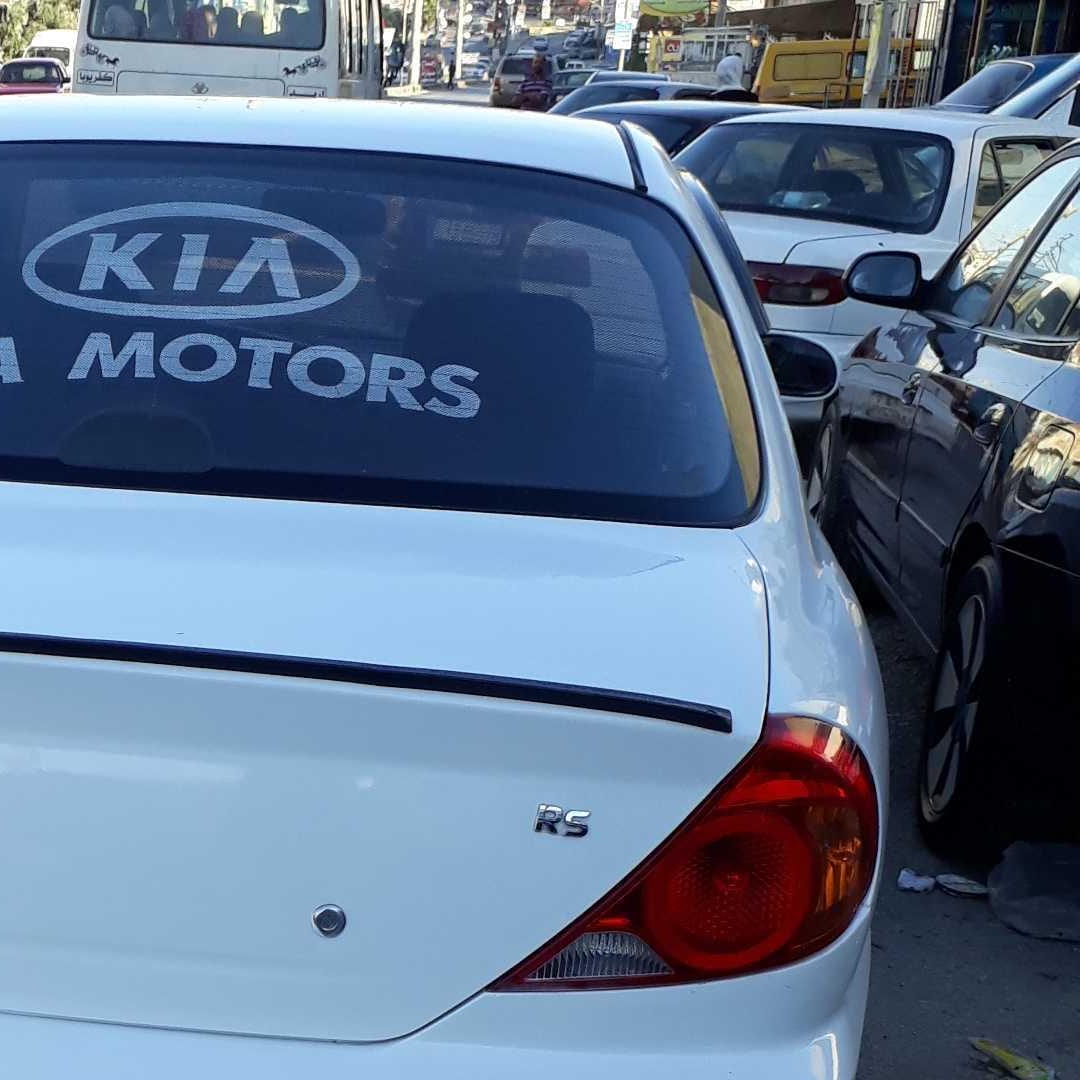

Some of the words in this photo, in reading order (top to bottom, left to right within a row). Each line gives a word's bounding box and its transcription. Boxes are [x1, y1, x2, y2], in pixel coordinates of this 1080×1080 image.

[77, 232, 302, 299] KIA
[67, 331, 482, 419] MOTORS
[534, 803, 591, 838] RS
